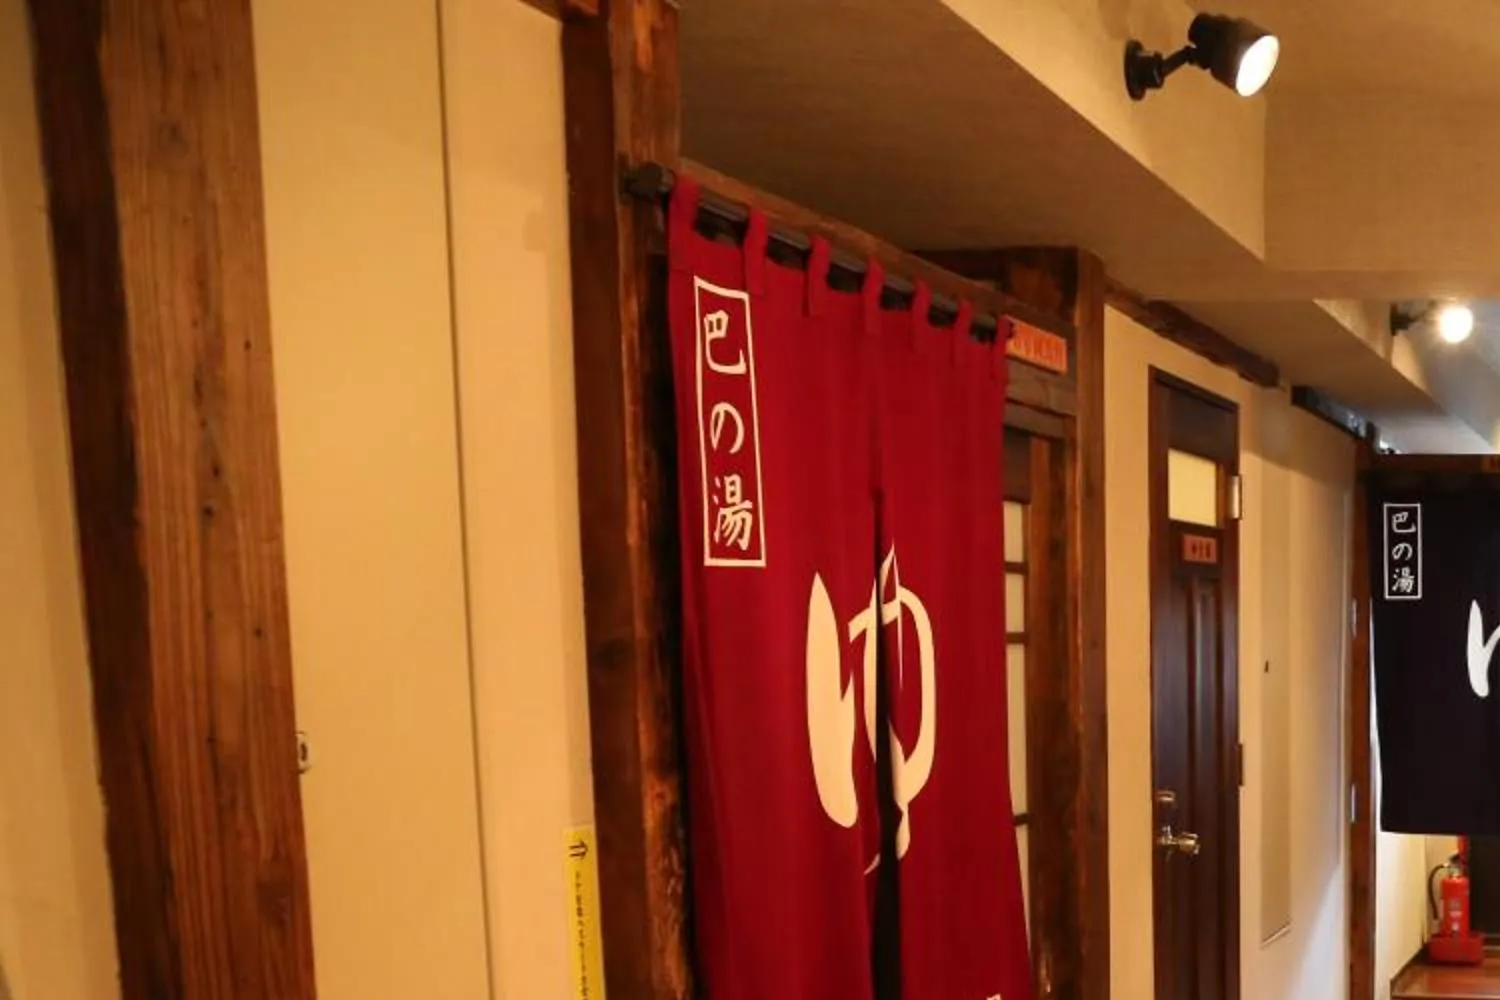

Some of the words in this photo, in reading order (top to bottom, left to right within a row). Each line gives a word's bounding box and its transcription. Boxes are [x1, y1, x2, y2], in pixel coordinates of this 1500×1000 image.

[703, 309, 754, 551] 巴の湯
[1391, 512, 1417, 594] 巴の湯
[806, 543, 936, 875] ゆ
